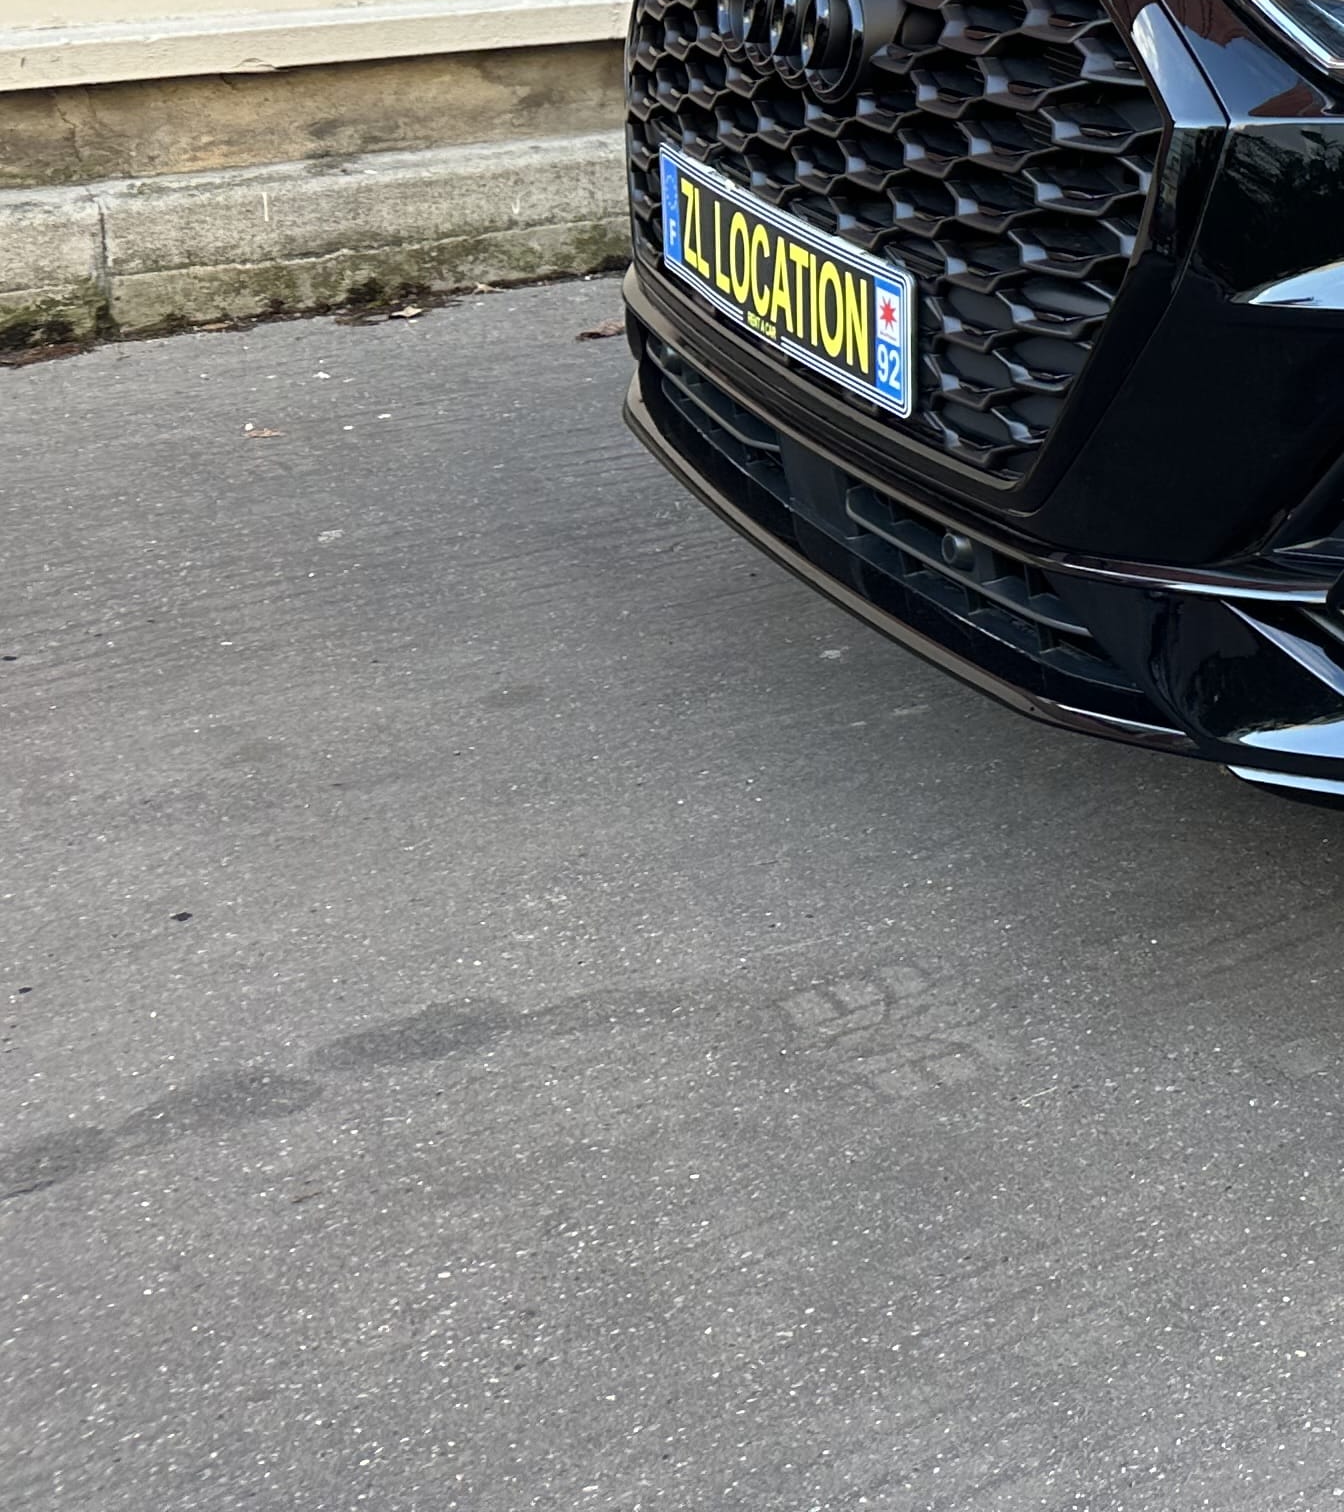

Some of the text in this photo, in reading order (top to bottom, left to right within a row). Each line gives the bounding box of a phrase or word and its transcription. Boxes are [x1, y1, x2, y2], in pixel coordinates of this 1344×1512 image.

[680, 177, 869, 374] ZL LOCATION
[877, 344, 901, 390] 92
